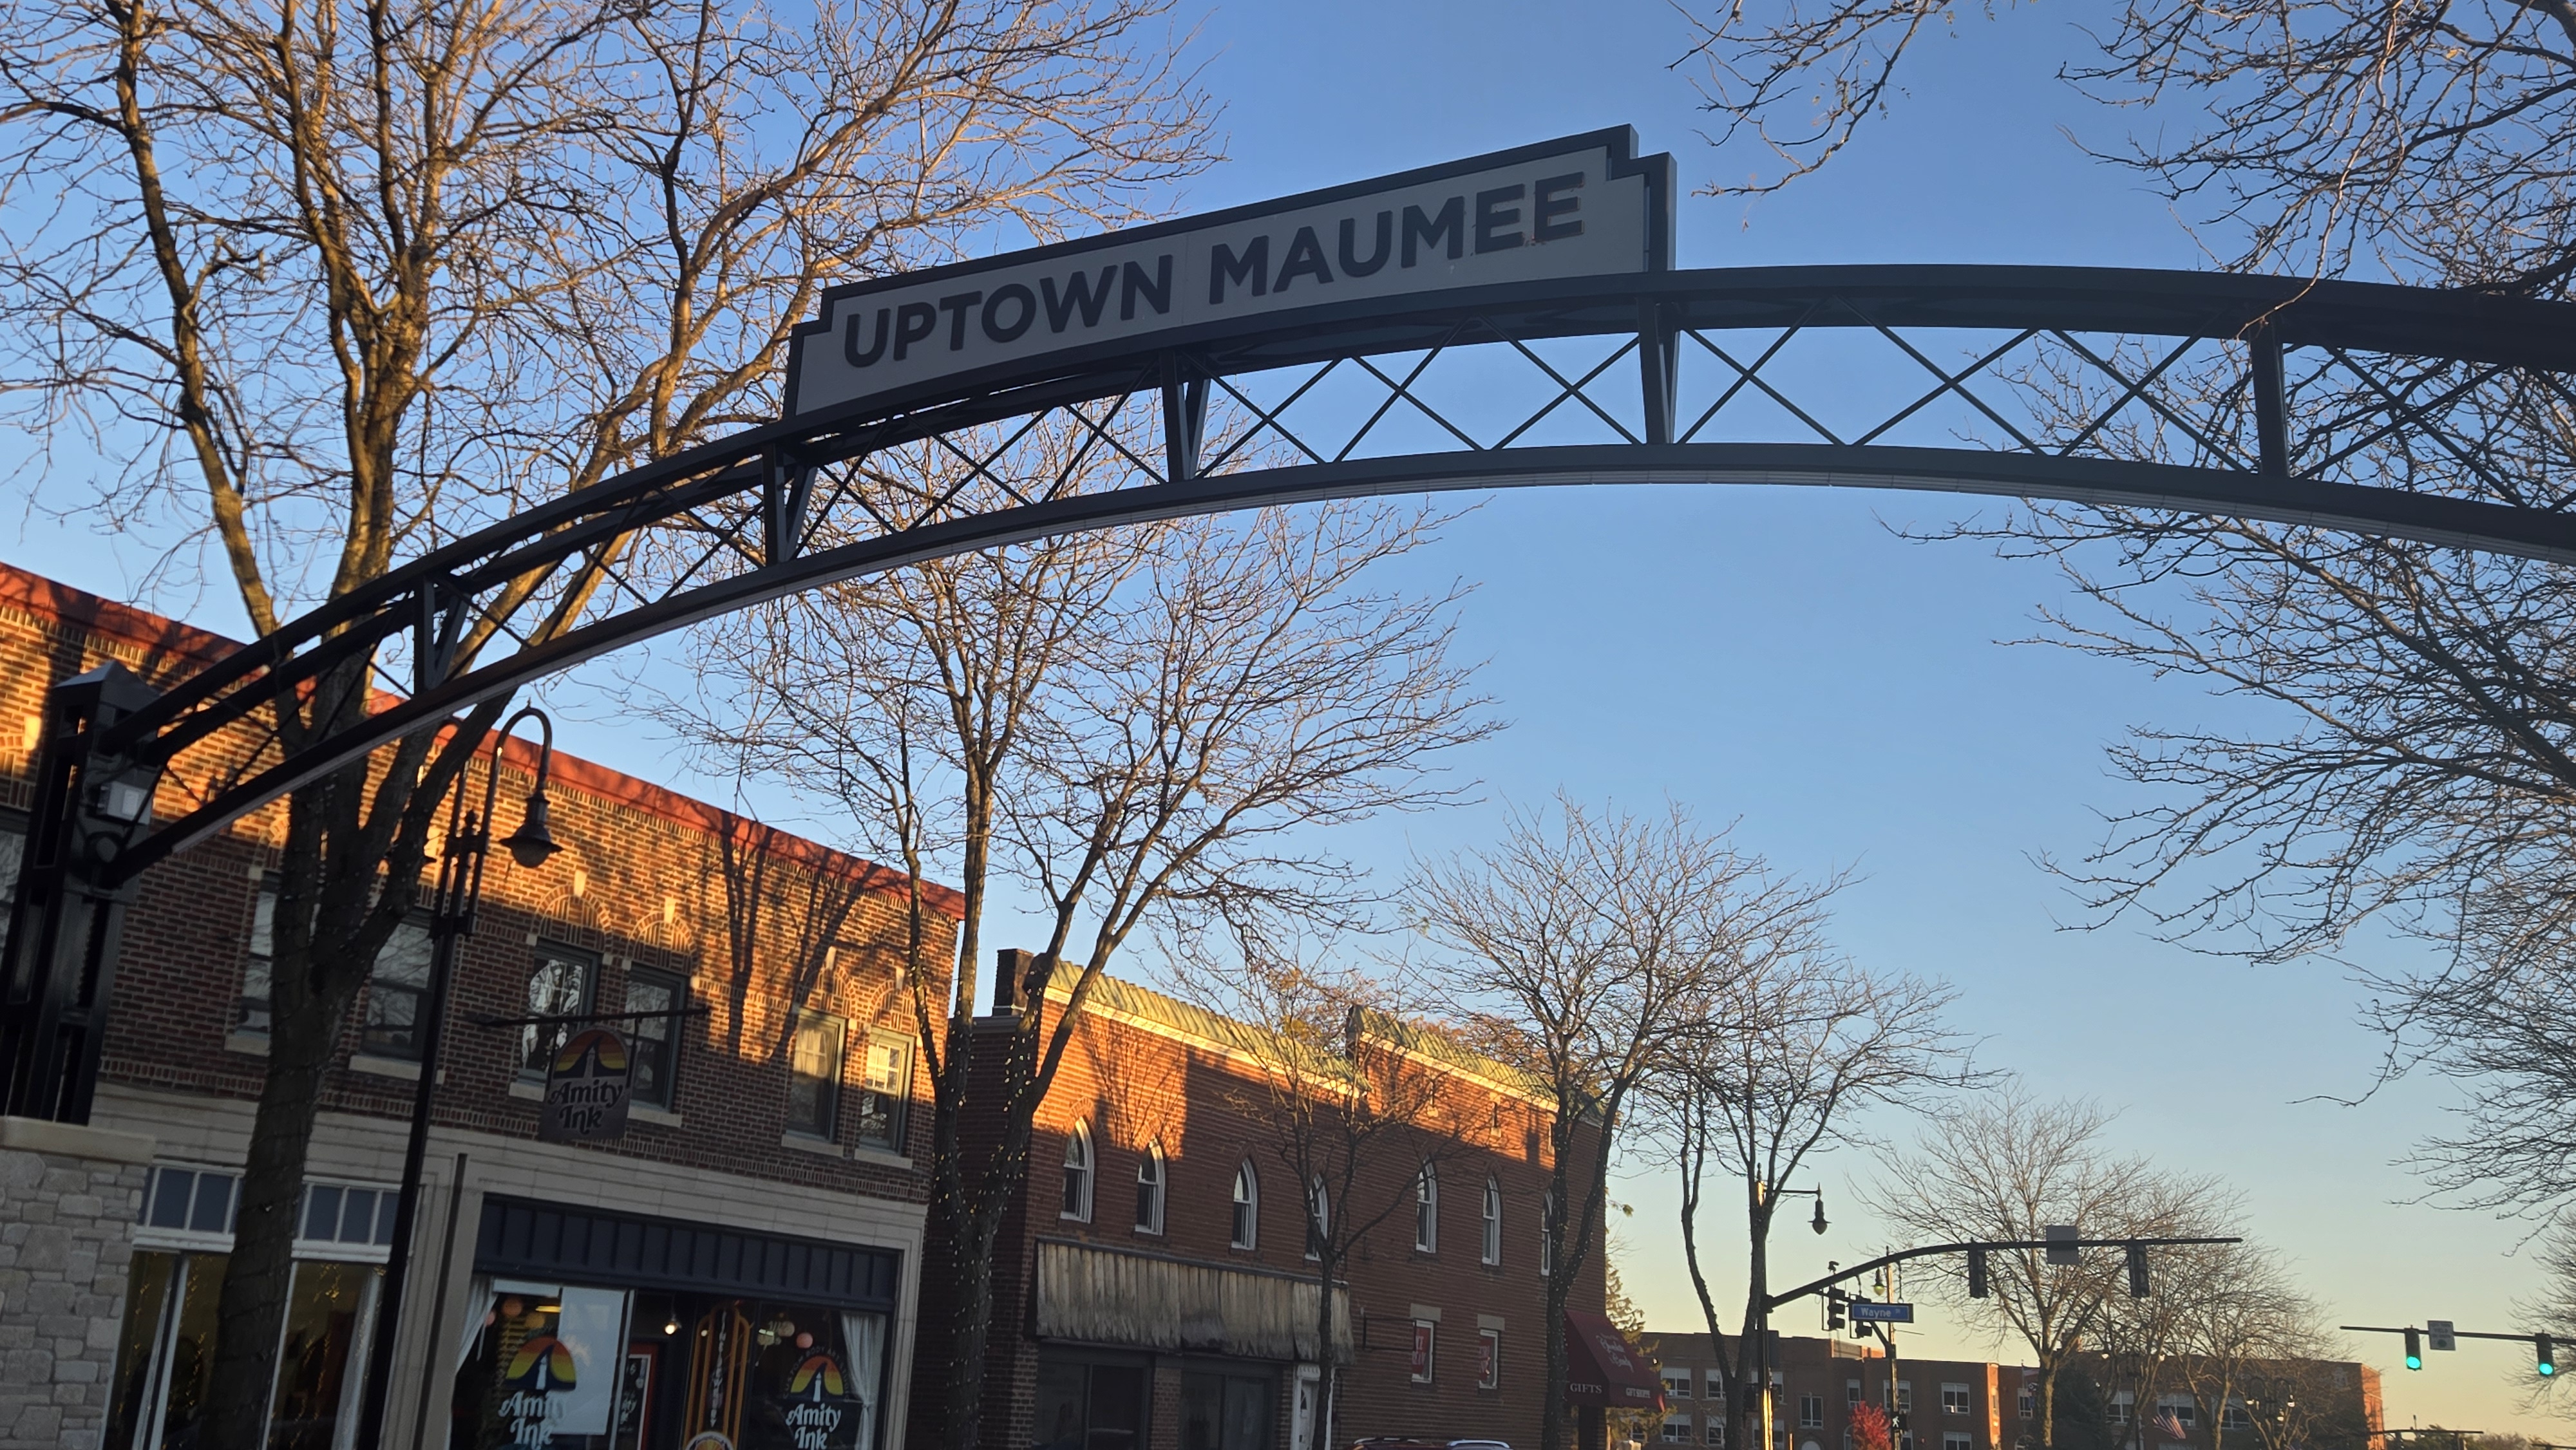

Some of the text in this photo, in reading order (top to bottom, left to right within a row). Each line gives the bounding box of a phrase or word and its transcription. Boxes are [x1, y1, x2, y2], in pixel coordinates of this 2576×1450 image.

[844, 171, 1585, 368] UPTOWN MAUMEE
[547, 1078, 623, 1108] Amity
[559, 1104, 603, 1135] Ink
[1861, 1306, 1892, 1319] Wayne
[1569, 1382, 1603, 1395] GIFTS
[785, 1402, 842, 1433] Amity
[509, 1417, 555, 1450] Ink
[794, 1426, 828, 1450] Ink
